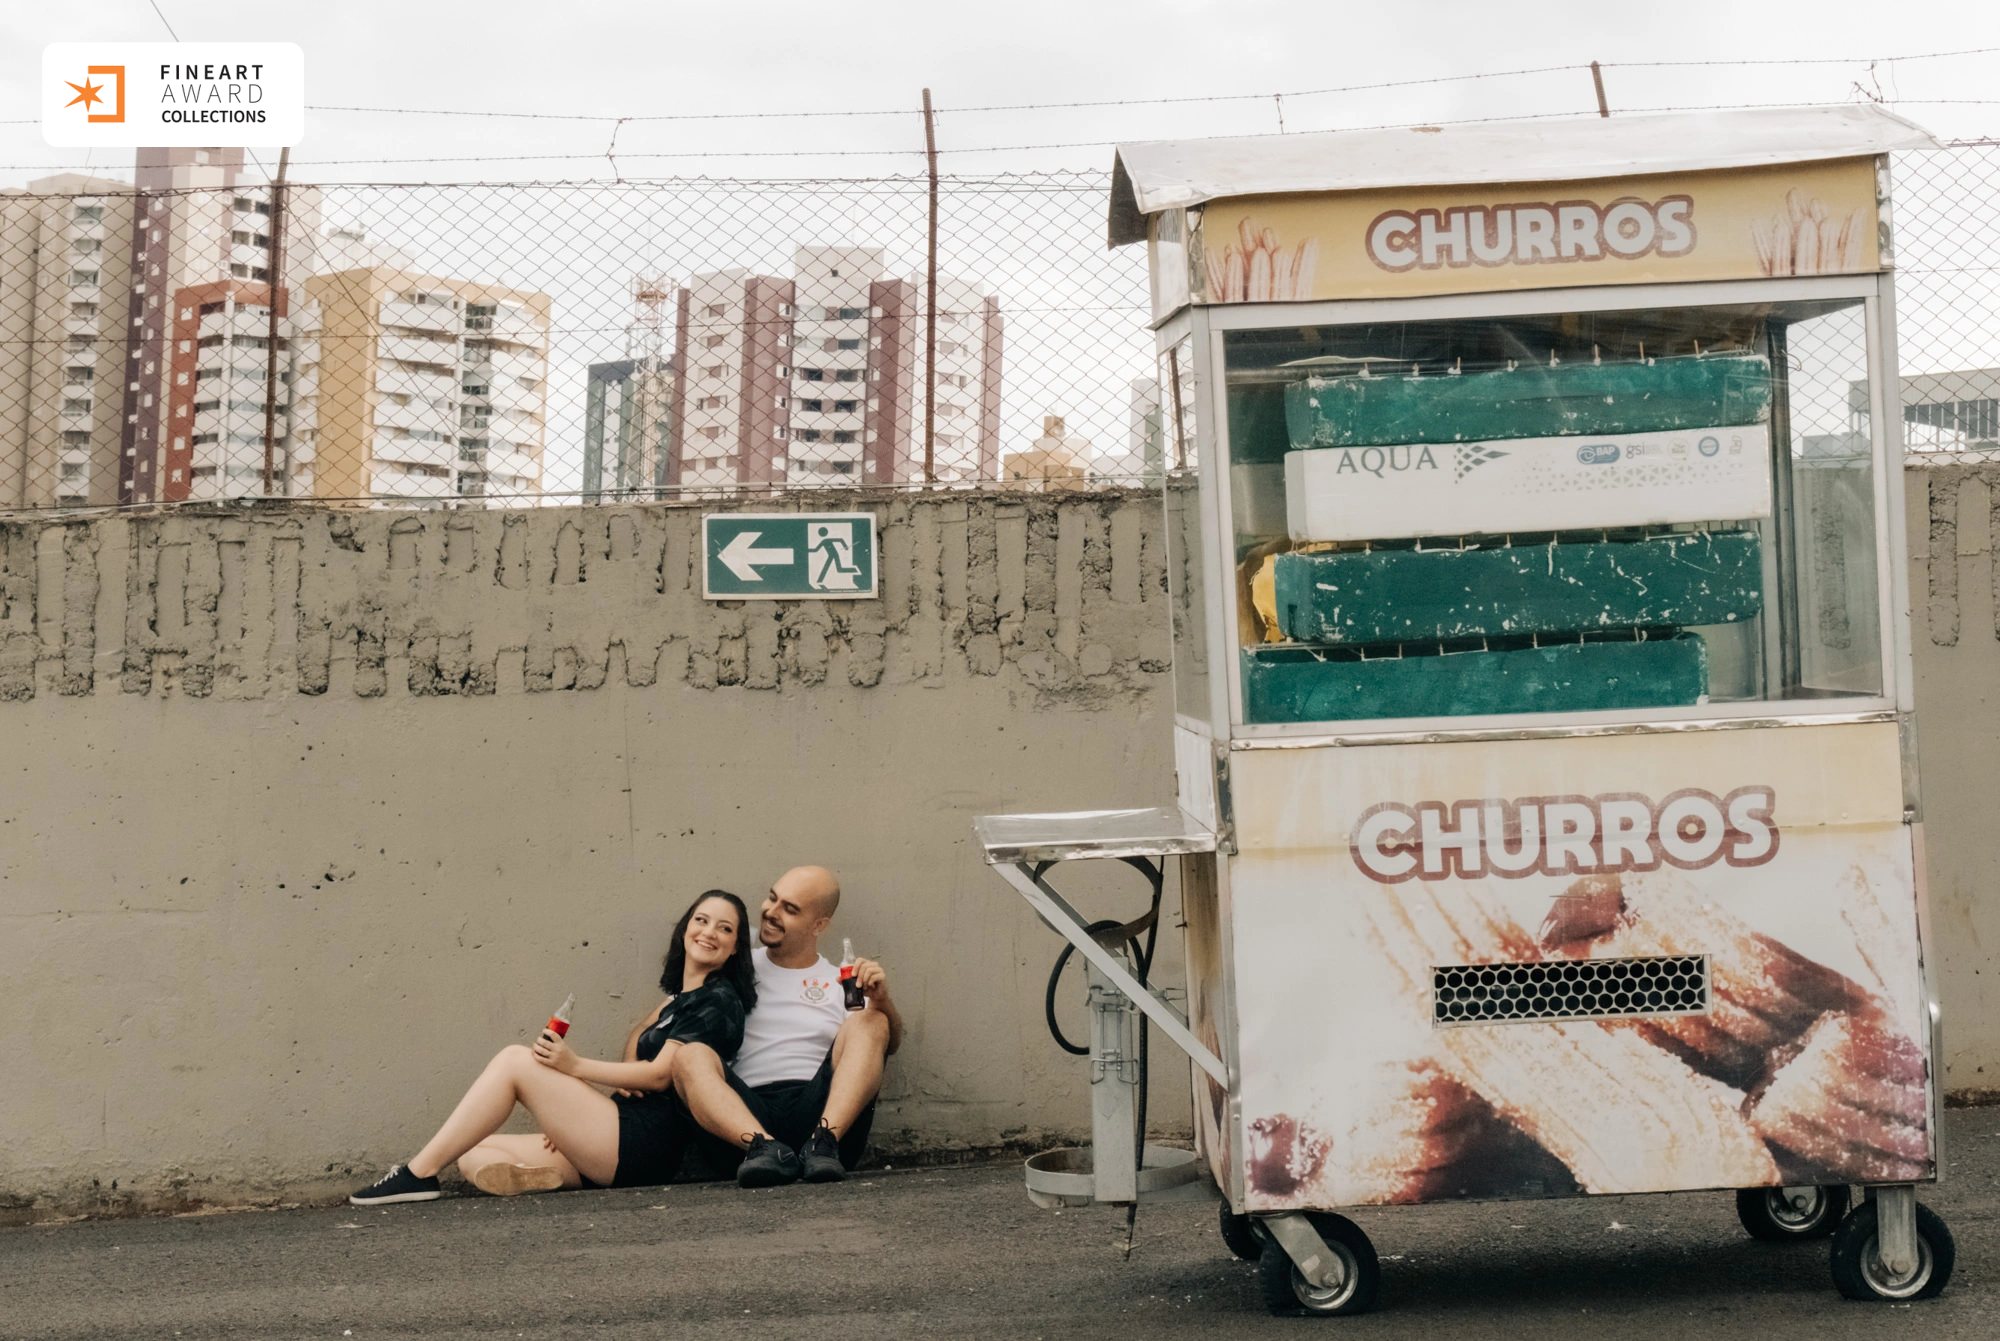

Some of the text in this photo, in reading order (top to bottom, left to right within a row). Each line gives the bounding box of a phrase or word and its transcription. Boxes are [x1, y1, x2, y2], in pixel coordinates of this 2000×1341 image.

[1365, 194, 1697, 273] CHURROS
[1336, 446, 1439, 479] AQUA
[1595, 446, 1616, 457] BAP
[1625, 442, 1646, 460] gsi
[1349, 785, 1781, 884] CHURROS
